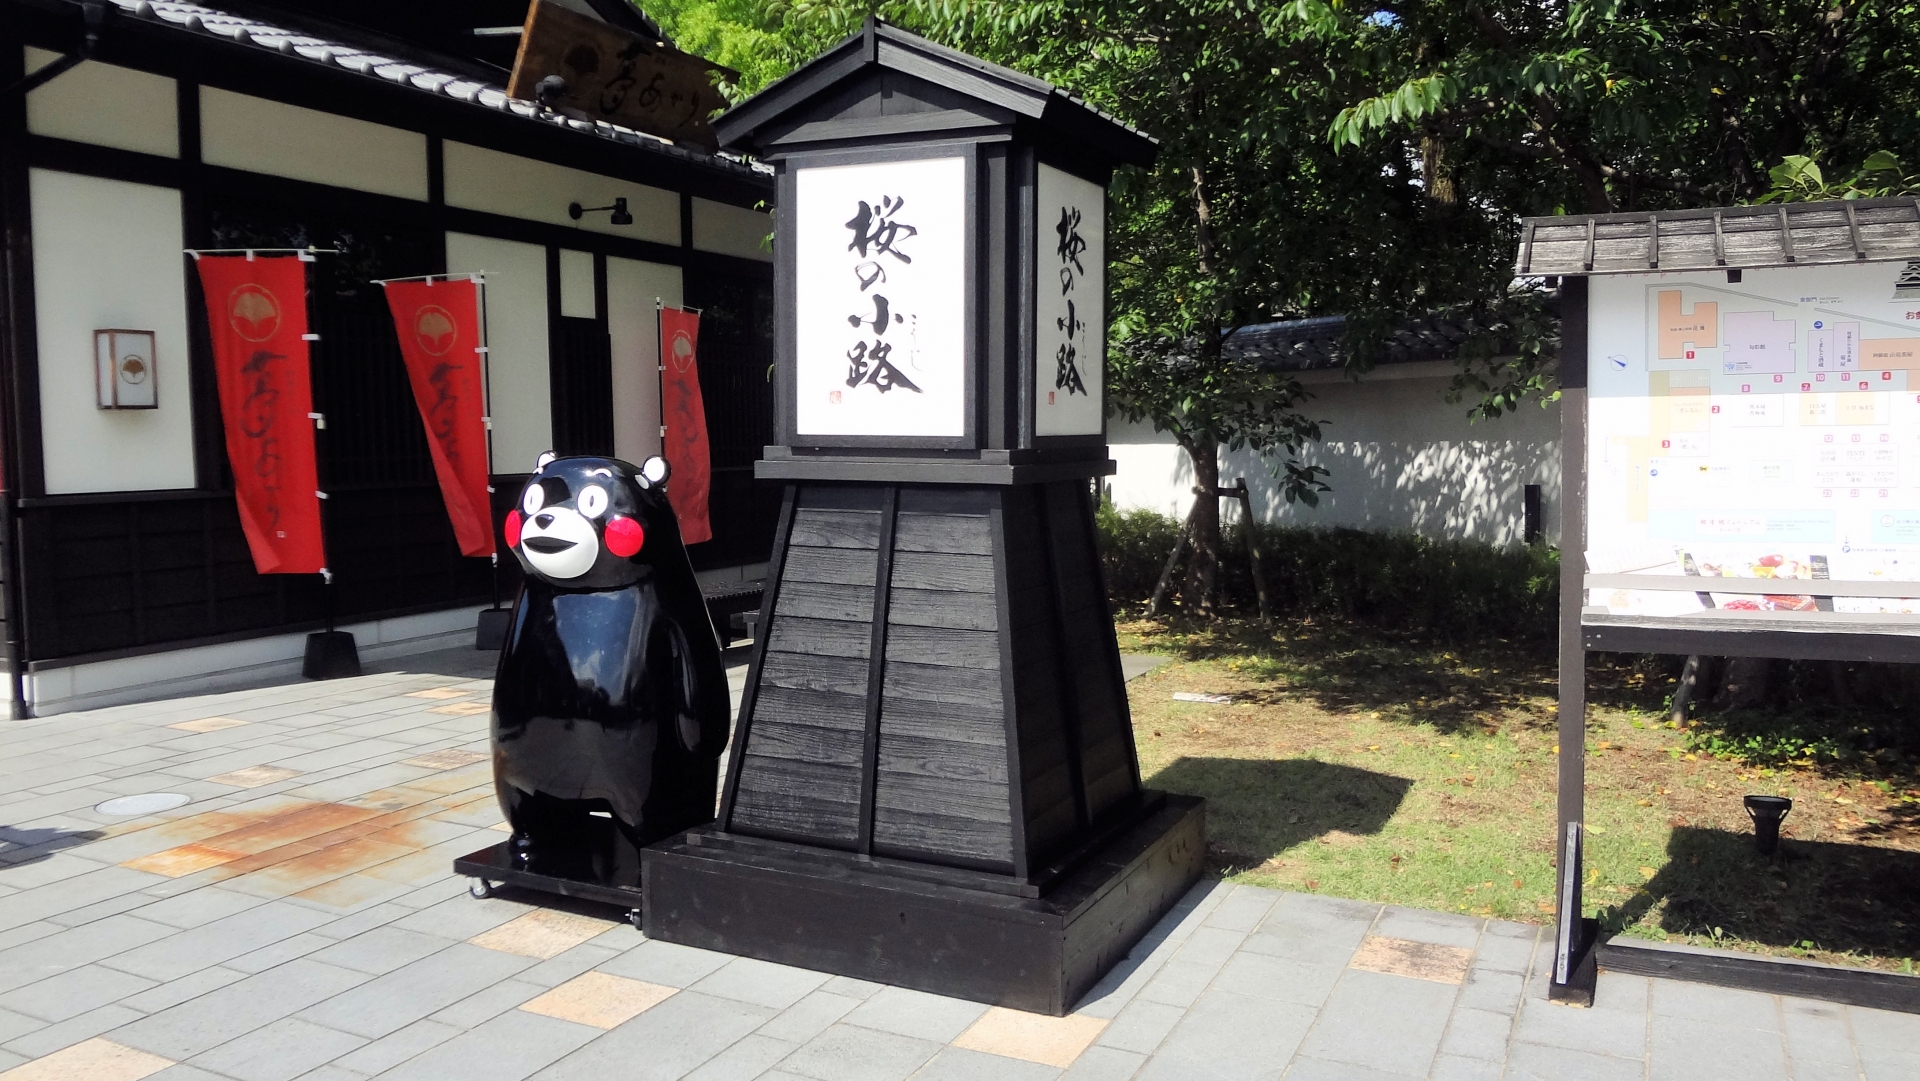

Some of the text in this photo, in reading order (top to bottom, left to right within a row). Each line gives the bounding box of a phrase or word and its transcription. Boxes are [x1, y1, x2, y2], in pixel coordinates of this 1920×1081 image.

[844, 195, 924, 394] 桜の小路
[1055, 205, 1088, 397] 桜の小路
